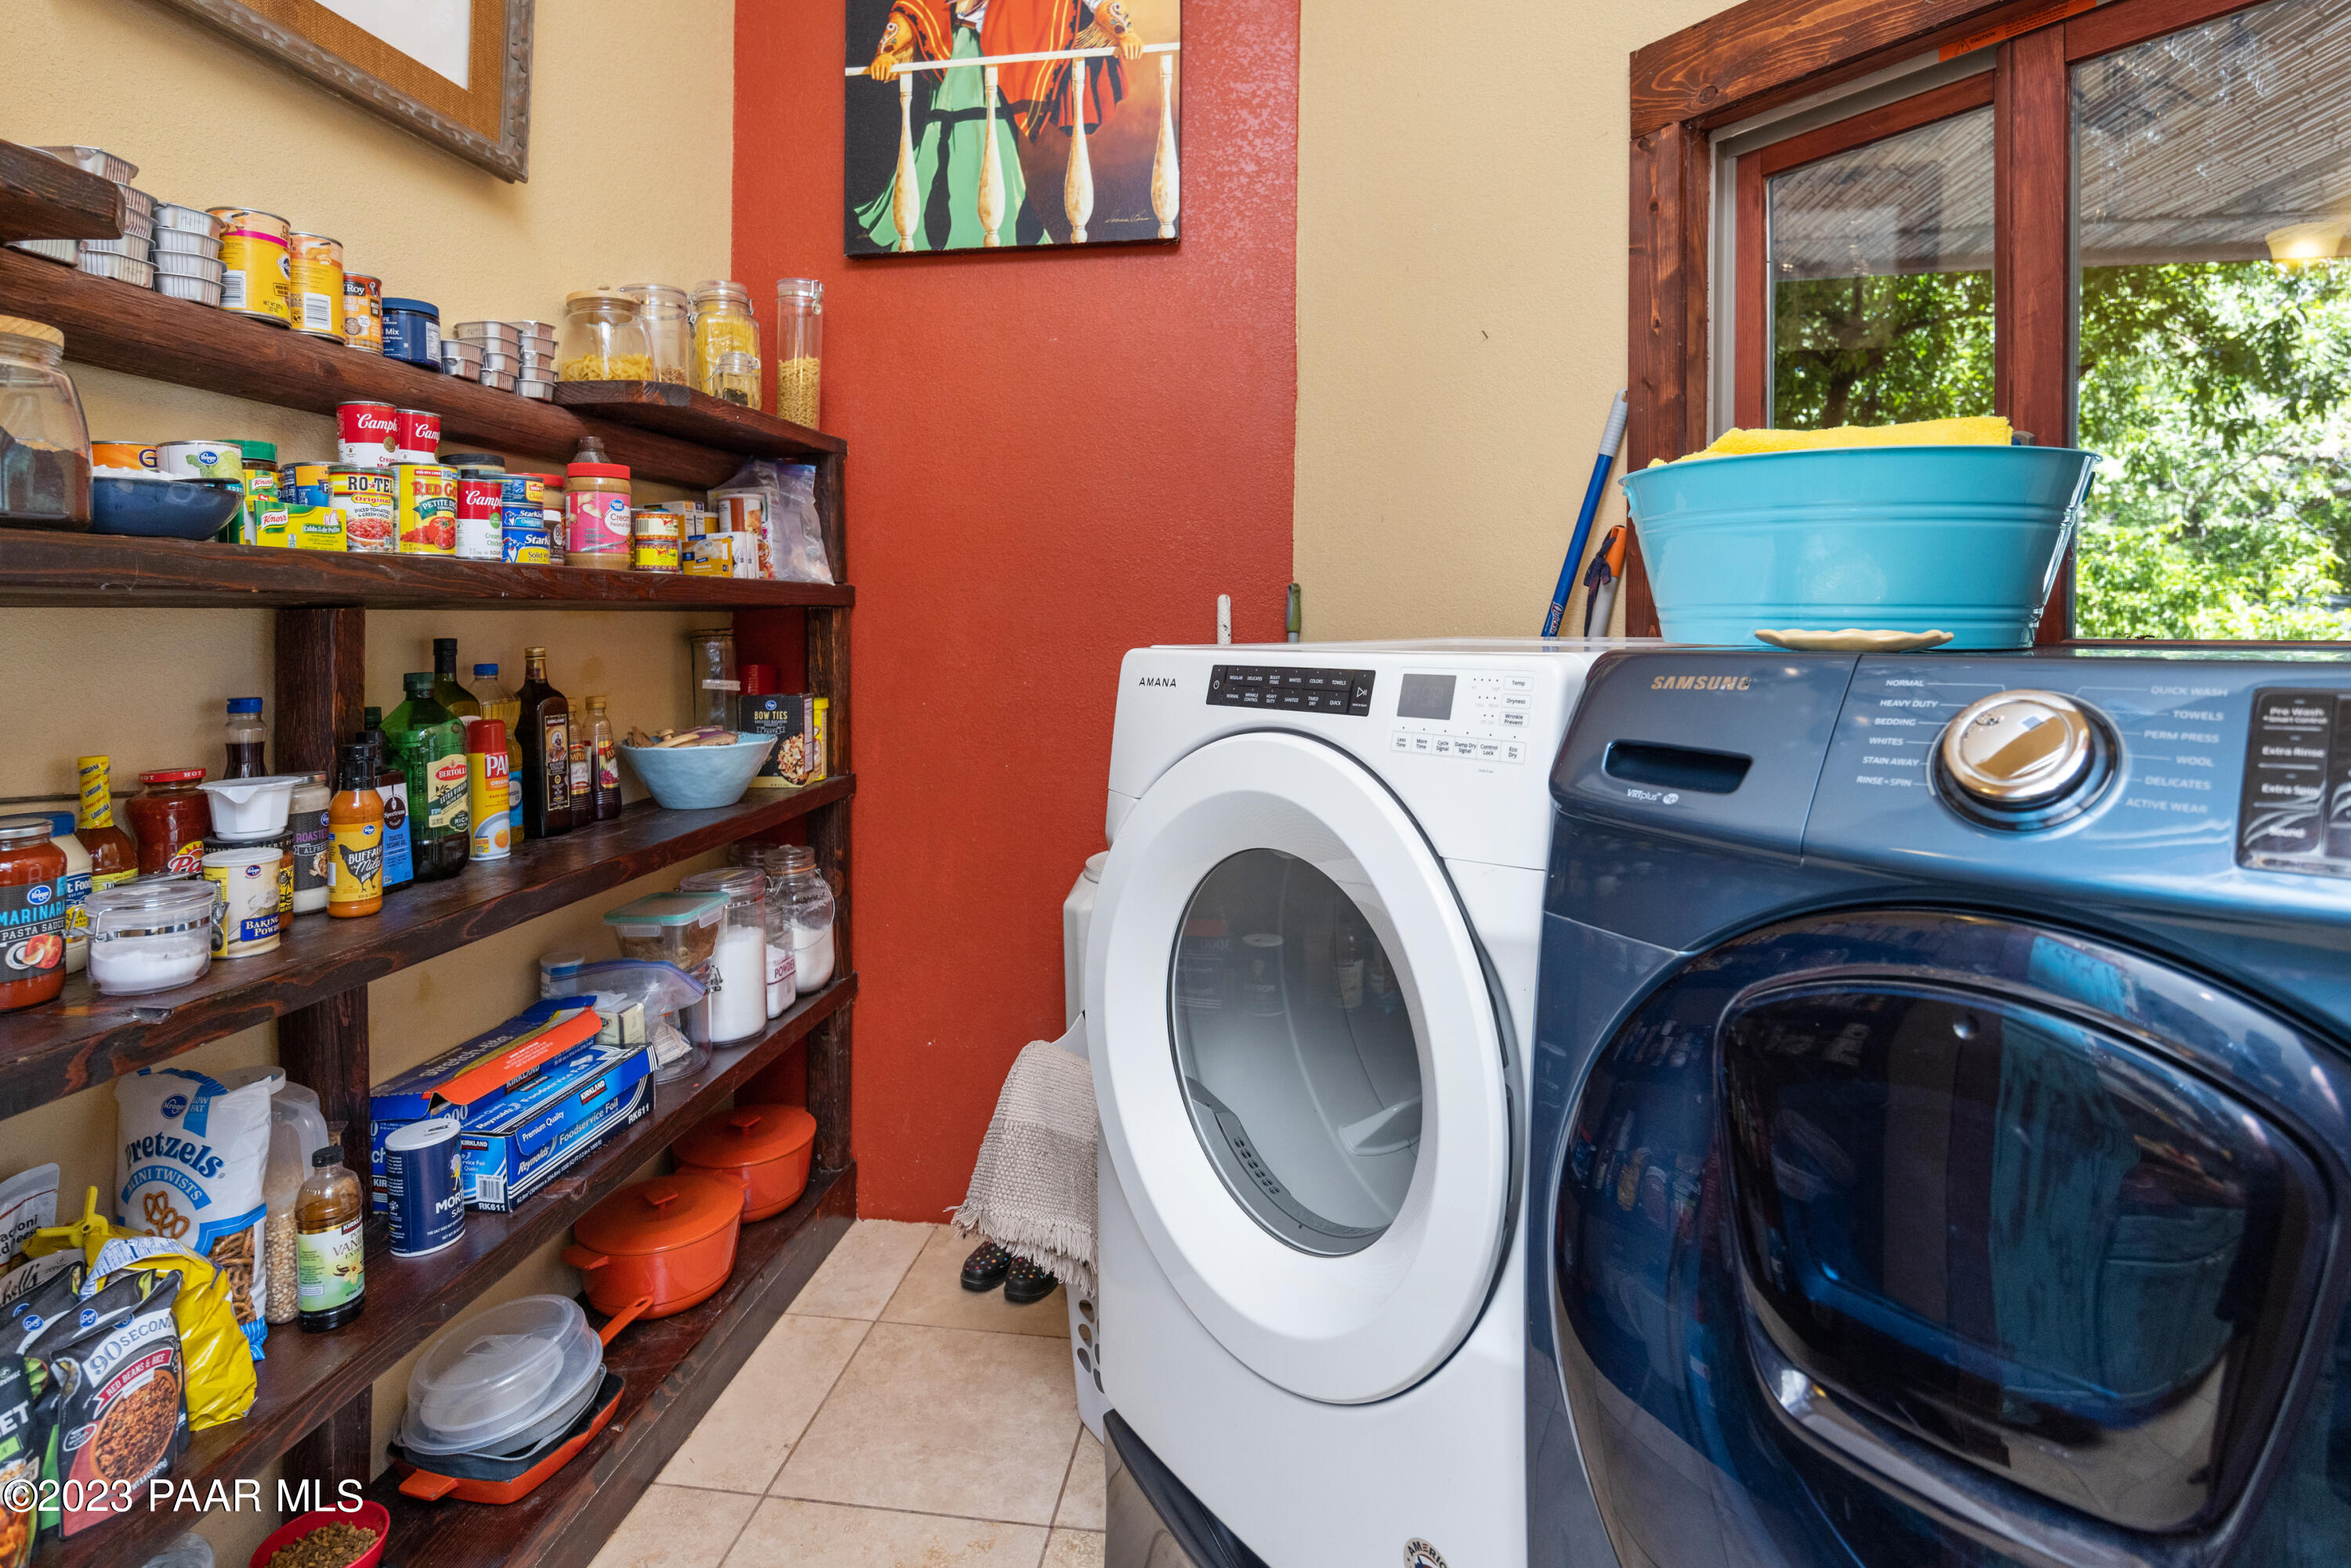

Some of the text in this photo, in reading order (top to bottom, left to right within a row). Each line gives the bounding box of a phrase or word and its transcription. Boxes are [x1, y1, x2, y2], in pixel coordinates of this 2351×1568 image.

[201, 452, 218, 463] Kroger
[411, 481, 442, 497] RED
[422, 499, 448, 509] PETITE
[263, 514, 287, 524] Knorr
[1549, 601, 1564, 635] Quickie
[1139, 677, 1176, 688] AMANA
[1650, 675, 1751, 690] SAMSUNG
[2150, 686, 2229, 697] QUICK WASH
[2173, 710, 2224, 721] TOWELS
[2269, 707, 2324, 716] Pre Wash
[1869, 737, 1904, 746] WHITES
[2144, 730, 2219, 743] PERM PRESS
[2262, 746, 2325, 759] Extra Rinse
[1862, 756, 1889, 765] STAIN
[2175, 755, 2214, 768] WOOL
[1856, 776, 1912, 787] RINSE SPIN
[2144, 776, 2212, 791] DELICATES
[2262, 784, 2320, 797] Extra Spin
[440, 791, 453, 804] EXTRA
[447, 797, 456, 806] OLIVE
[2125, 798, 2208, 813] ACTIVE WEAR
[384, 809, 405, 819] Spectrum
[2268, 826, 2306, 838] Sound
[349, 846, 382, 865] BUFFALO
[31, 890, 49, 901] Kroger
[245, 916, 279, 930] BAKING
[2, 920, 64, 940] PASTA SAUCE
[580, 1080, 606, 1100] KIRKLAND
[163, 1099, 187, 1114] Kroger
[476, 1108, 512, 1129] Reynolds
[629, 1103, 650, 1124] RK611
[522, 1110, 564, 1142] Premium Quality
[518, 1097, 618, 1175] Reynolds Foodservice Foil
[125, 1132, 224, 1179] Pretzels
[125, 1168, 202, 1200] MINI TWISTS
[89, 1342, 122, 1375] 90
[107, 1382, 121, 1396] RED
[122, 1363, 144, 1383] BEANS
[152, 1354, 165, 1365] RICE
